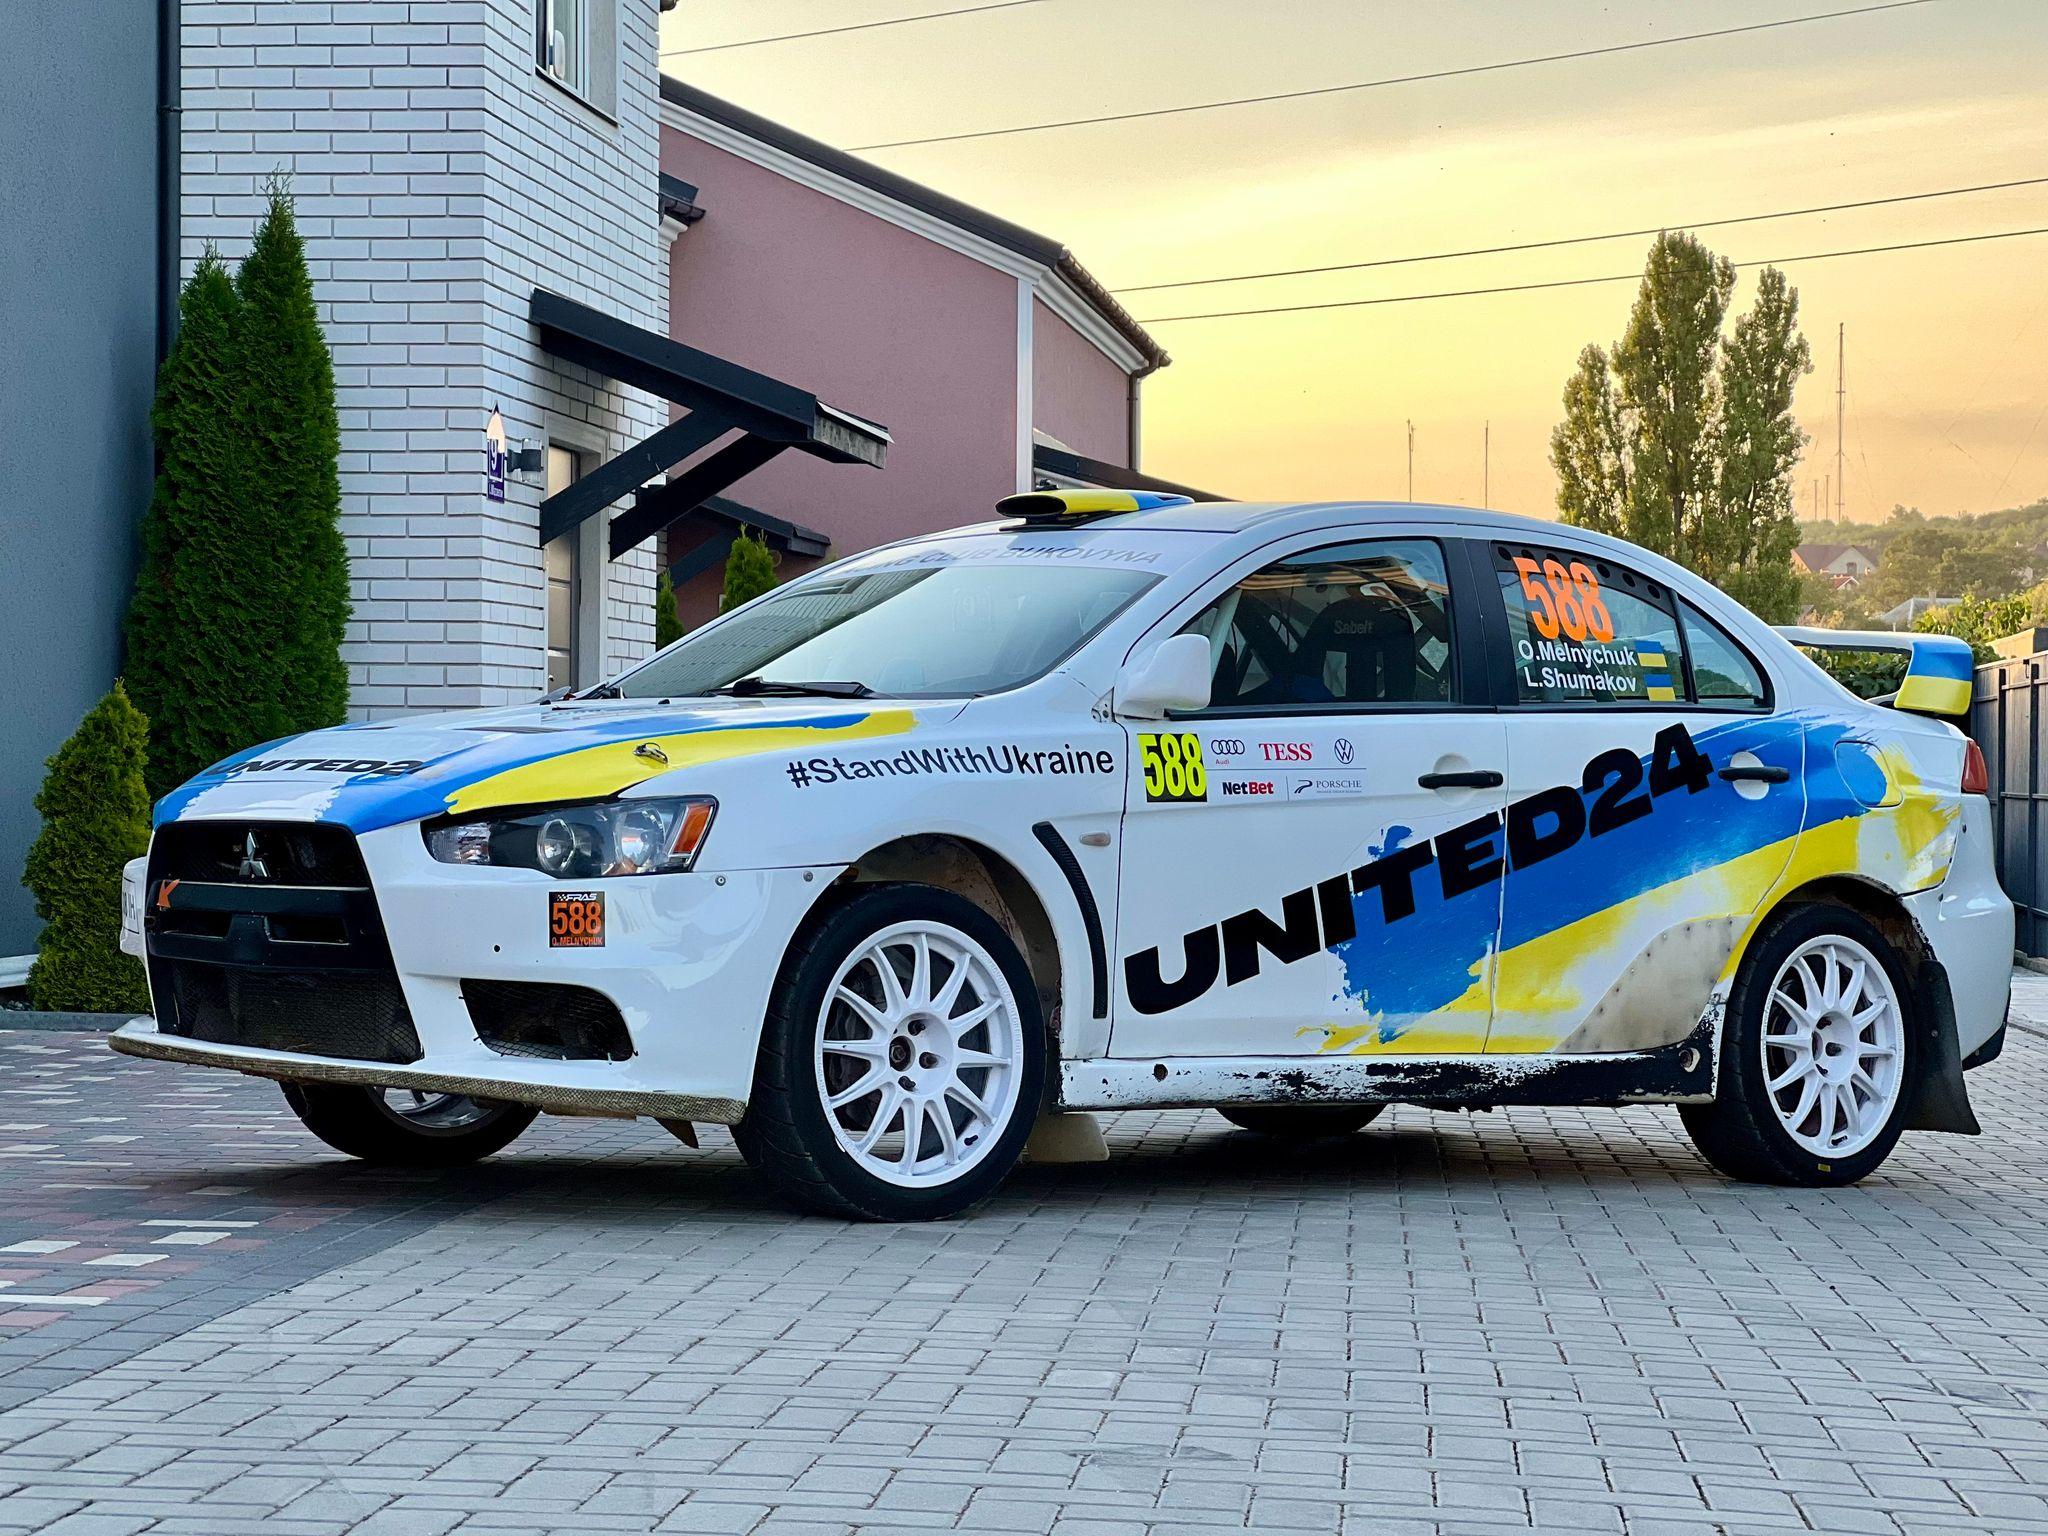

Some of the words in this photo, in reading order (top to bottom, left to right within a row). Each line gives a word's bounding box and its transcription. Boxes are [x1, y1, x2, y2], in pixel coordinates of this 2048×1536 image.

[1513, 556, 1614, 644] 588
[1333, 619, 1374, 635] Sabelt
[1517, 639, 1638, 668] O.Melnychuk
[1524, 666, 1637, 692] L.Shumakov
[1215, 758, 1230, 766] Audi
[1259, 742, 1313, 761] TESS
[786, 743, 1114, 788] #StandWithUkraine
[1137, 733, 1207, 797] 588
[1222, 781, 1274, 795] NetBet
[1315, 780, 1362, 788] PORSCHE
[1124, 722, 1714, 1015] UNITED24
[552, 902, 601, 934] 588
[560, 936, 603, 946] MELNYCHUK
